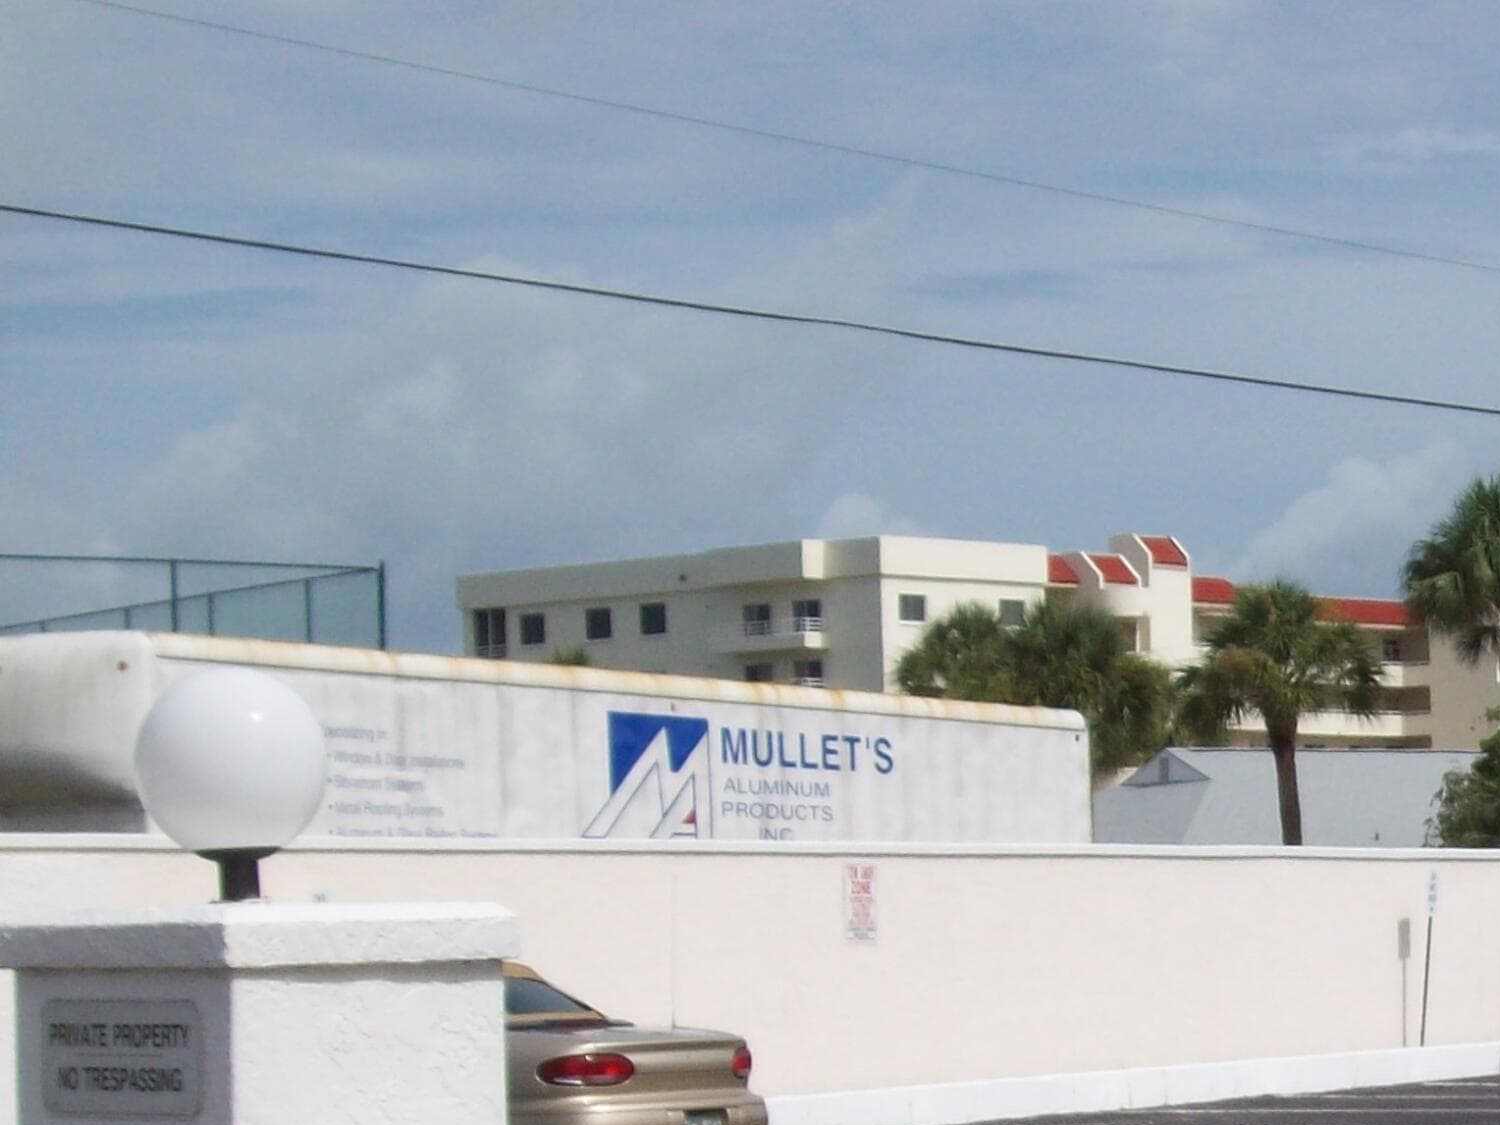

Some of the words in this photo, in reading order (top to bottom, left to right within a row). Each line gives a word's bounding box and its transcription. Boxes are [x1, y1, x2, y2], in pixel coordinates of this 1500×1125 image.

[720, 727, 894, 775] MULLET'S
[723, 777, 830, 798] ALUMINUM
[721, 802, 834, 822] PRODUCTS
[49, 1022, 108, 1048] PRIVATE
[112, 1023, 191, 1048] PROPERTY
[57, 1066, 78, 1091] NO
[82, 1066, 184, 1093] TRESPASSING
